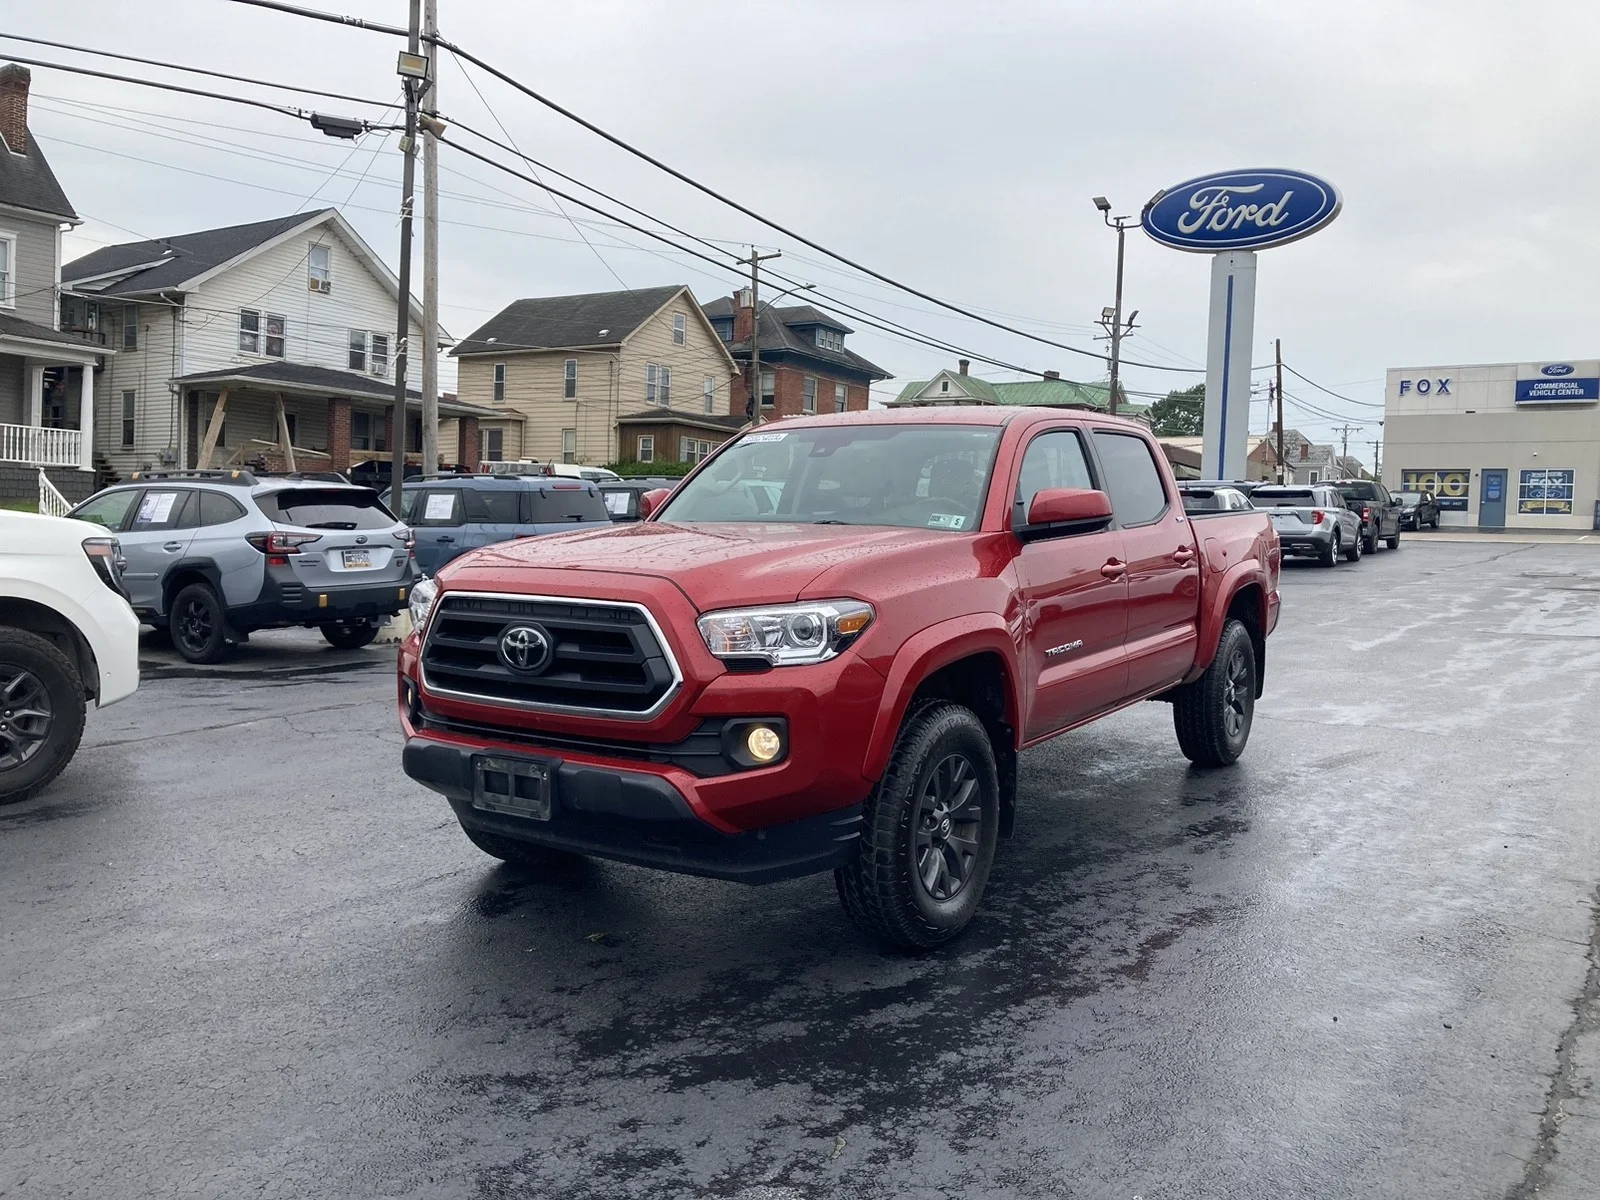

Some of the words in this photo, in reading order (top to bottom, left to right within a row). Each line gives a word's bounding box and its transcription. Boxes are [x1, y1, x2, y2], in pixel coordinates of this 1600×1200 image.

[1177, 183, 1295, 234] Ford
[1547, 366, 1568, 374] Ford
[1399, 378, 1452, 397] FOX
[1534, 382, 1579, 390] COMMERCIAL
[1529, 478, 1564, 489] FOX
[1044, 639, 1084, 657] TACOMA
